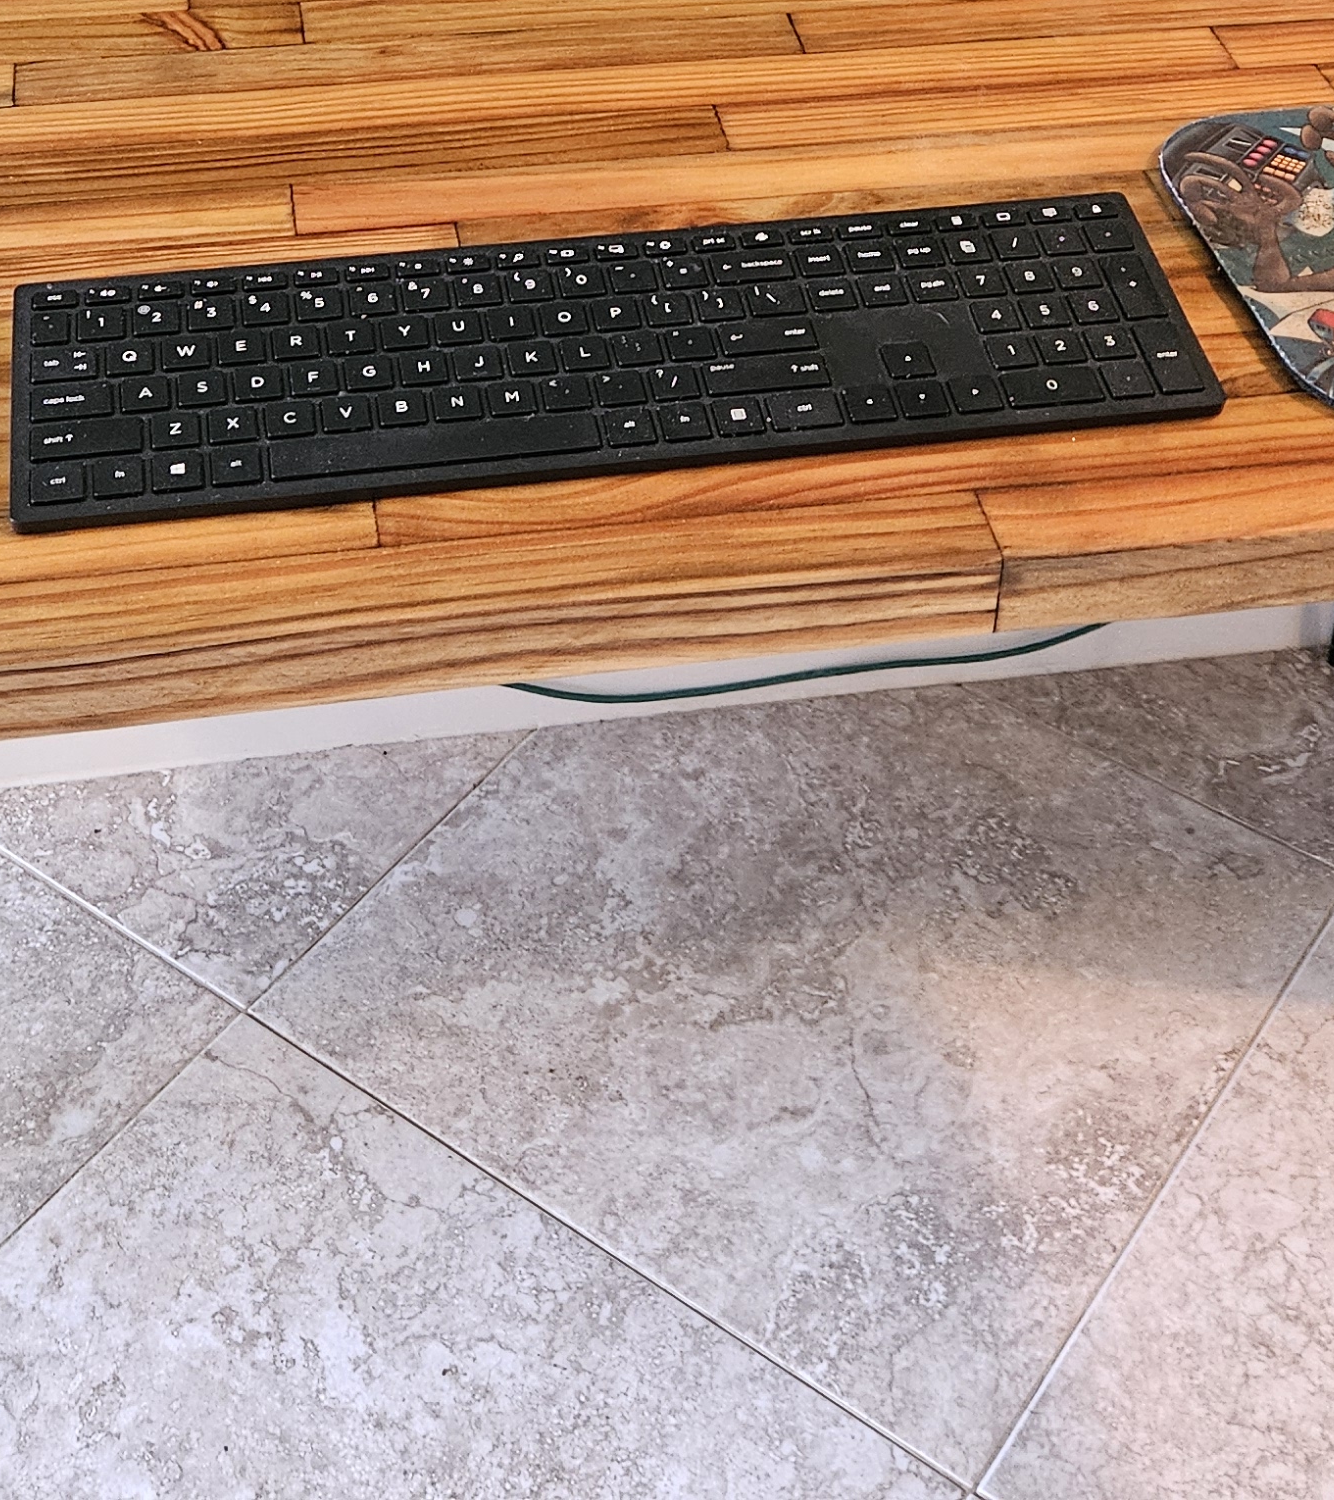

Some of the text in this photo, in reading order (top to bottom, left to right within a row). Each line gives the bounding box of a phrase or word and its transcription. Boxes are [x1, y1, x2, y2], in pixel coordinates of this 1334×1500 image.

[740, 259, 783, 268] backspace
[1024, 270, 1036, 281] 8
[1071, 266, 1083, 277] 9
[524, 278, 536, 290] 9
[975, 274, 986, 286] 7
[420, 287, 431, 299] 7
[472, 283, 484, 294] 8
[314, 297, 325, 308] 5
[367, 292, 379, 303] 6
[206, 306, 217, 318] 3
[259, 302, 271, 313] 4
[1039, 304, 1051, 316] 5
[1087, 300, 1100, 312] 6
[151, 311, 162, 323] 2
[557, 311, 572, 323] O
[609, 307, 622, 319] P
[991, 309, 1002, 320] 4
[398, 325, 411, 337] Y
[451, 320, 465, 332] U
[290, 335, 303, 347] R
[345, 330, 356, 342] T
[1103, 334, 1116, 347] 3
[176, 344, 196, 357] W
[235, 339, 247, 352] E
[1054, 339, 1067, 352] 2
[121, 350, 138, 362] Q
[525, 350, 538, 363] K
[579, 346, 591, 358] L
[417, 360, 431, 373] H
[474, 355, 485, 368] J
[307, 371, 319, 383] F
[362, 365, 377, 377] G
[197, 381, 208, 393] S
[250, 376, 265, 388] D
[138, 386, 153, 399] A
[504, 390, 520, 403] M
[395, 400, 409, 413] B
[450, 395, 464, 408] N
[283, 411, 297, 424] C
[339, 406, 353, 419] V
[169, 422, 182, 435] Z
[226, 417, 240, 430] X
